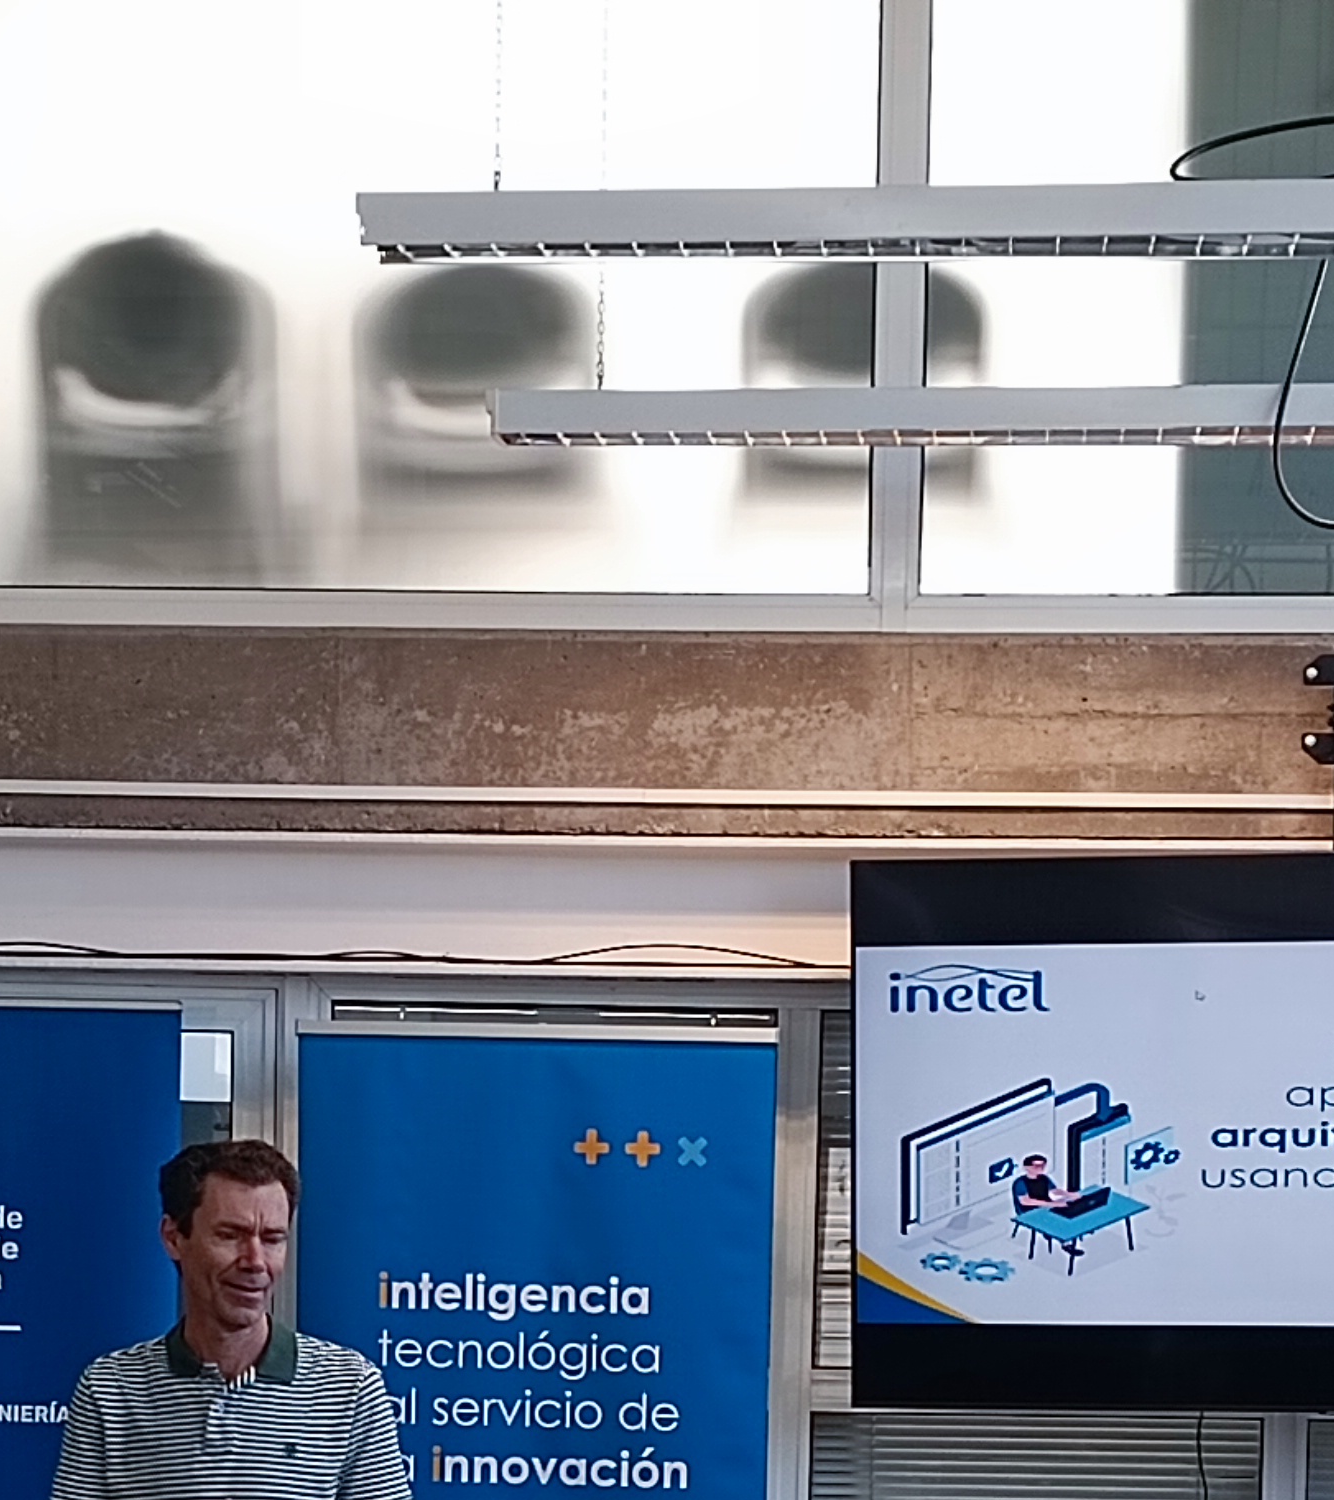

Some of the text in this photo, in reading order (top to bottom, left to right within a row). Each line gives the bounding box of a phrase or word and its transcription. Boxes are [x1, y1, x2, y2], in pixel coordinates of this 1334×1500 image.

[889, 964, 1051, 1014] inetel
[378, 1271, 651, 1322] inteligencia
[378, 1328, 661, 1382] tecnológica
[432, 1388, 603, 1430] servicio
[618, 1392, 680, 1433] de
[432, 1445, 688, 1490] innovación
